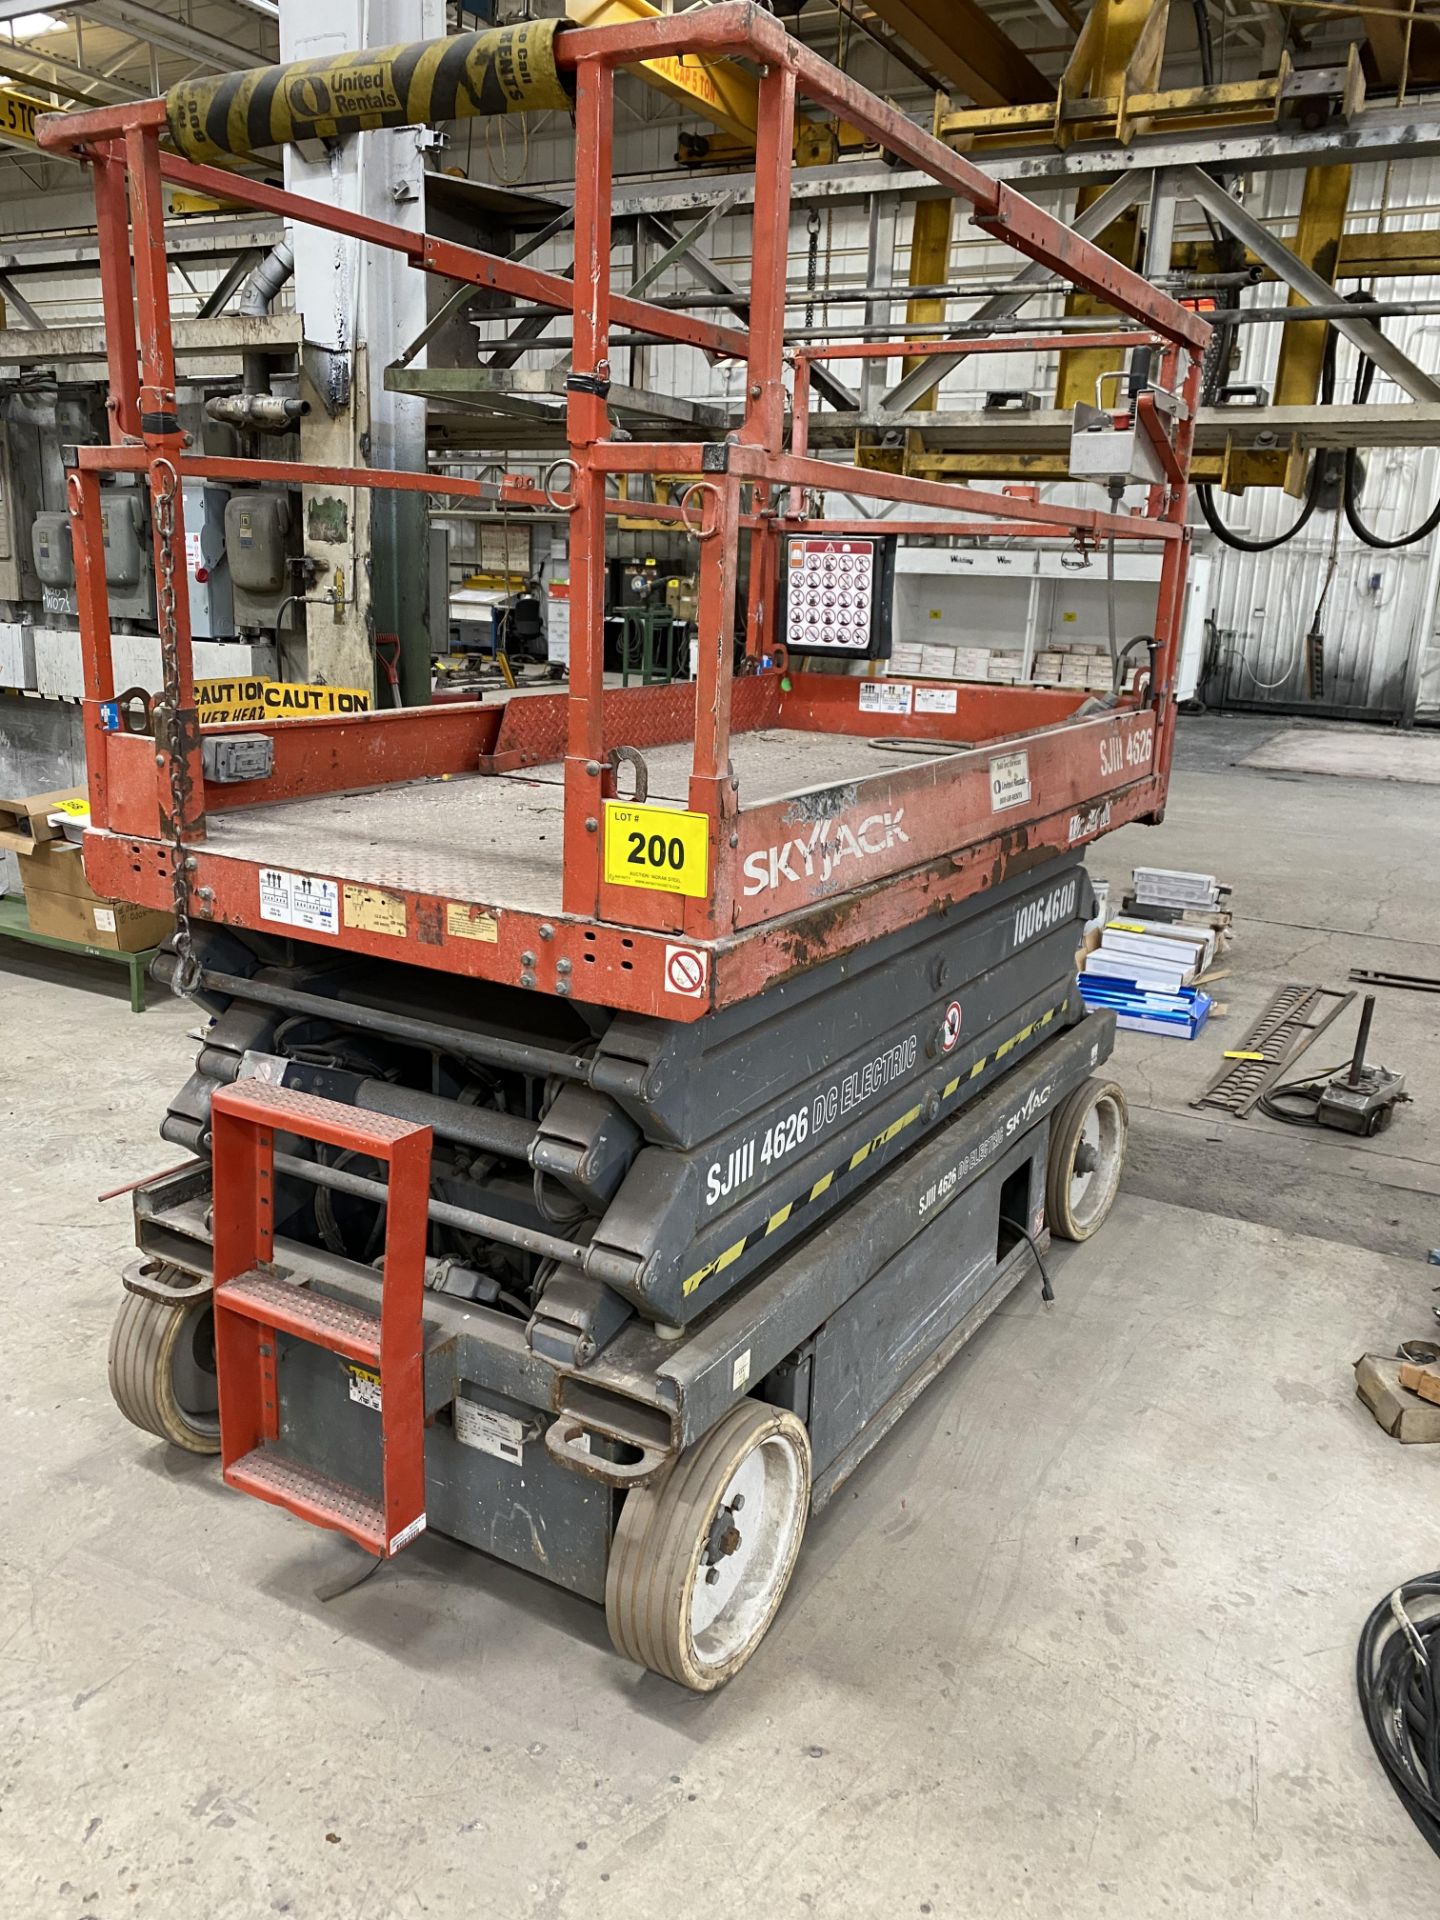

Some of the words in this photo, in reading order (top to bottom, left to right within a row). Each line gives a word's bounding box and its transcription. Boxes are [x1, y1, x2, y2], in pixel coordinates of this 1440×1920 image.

[331, 68, 384, 93] United
[700, 75, 716, 103] TON
[18, 102, 42, 136] TO
[336, 91, 397, 113] Rentals
[264, 688, 368, 713] CAUTION
[1126, 727, 1152, 767] 4626
[614, 812, 632, 822] LOT
[627, 832, 685, 871] 200
[743, 807, 911, 896] SKYJACK
[1013, 880, 1076, 947] 10064600
[760, 1106, 809, 1166] 4626
[812, 1086, 838, 1135] DC
[841, 1035, 917, 1116] ELECTRIC
[937, 1167, 957, 1197] 4626
[1005, 1083, 1057, 1137] SKYJAC
